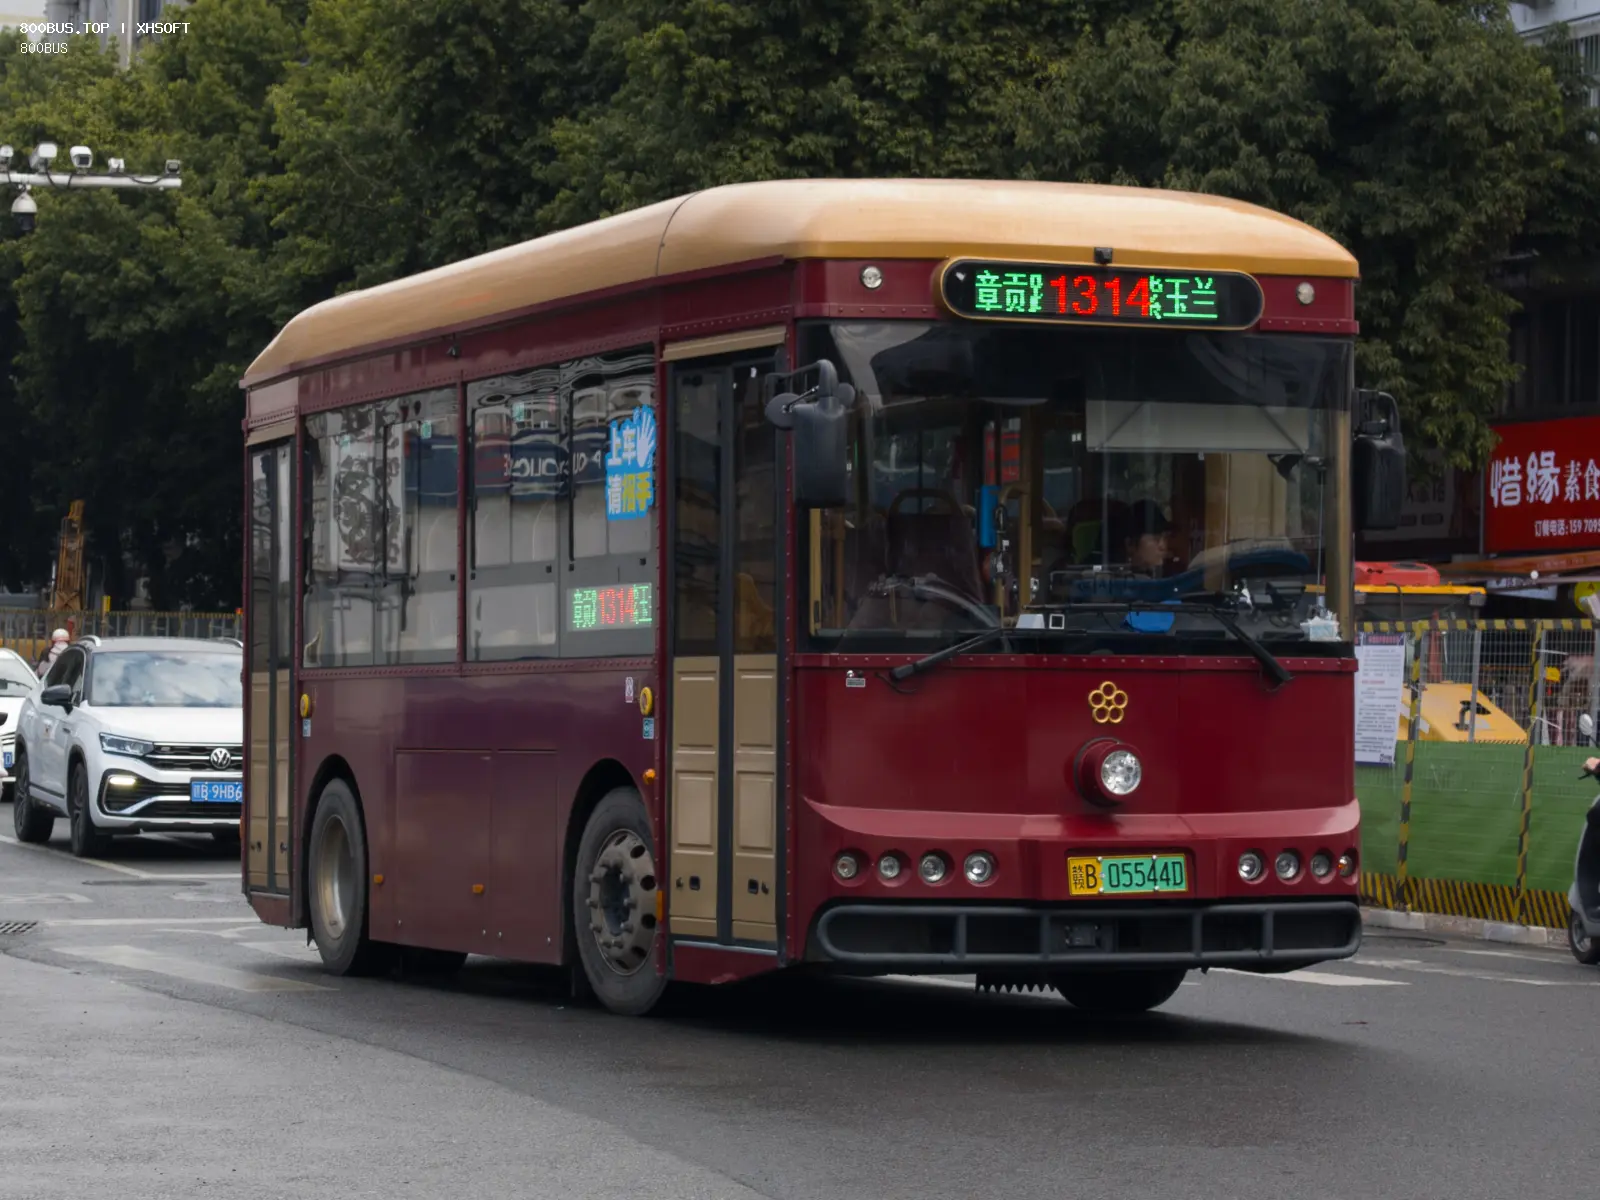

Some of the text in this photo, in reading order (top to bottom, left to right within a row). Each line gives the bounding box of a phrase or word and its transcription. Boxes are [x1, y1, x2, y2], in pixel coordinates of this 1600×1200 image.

[1050, 275, 1149, 317] 1314
[608, 424, 637, 466] 上车
[598, 587, 634, 626] 1314
[1107, 860, 1184, 888] 05544D
